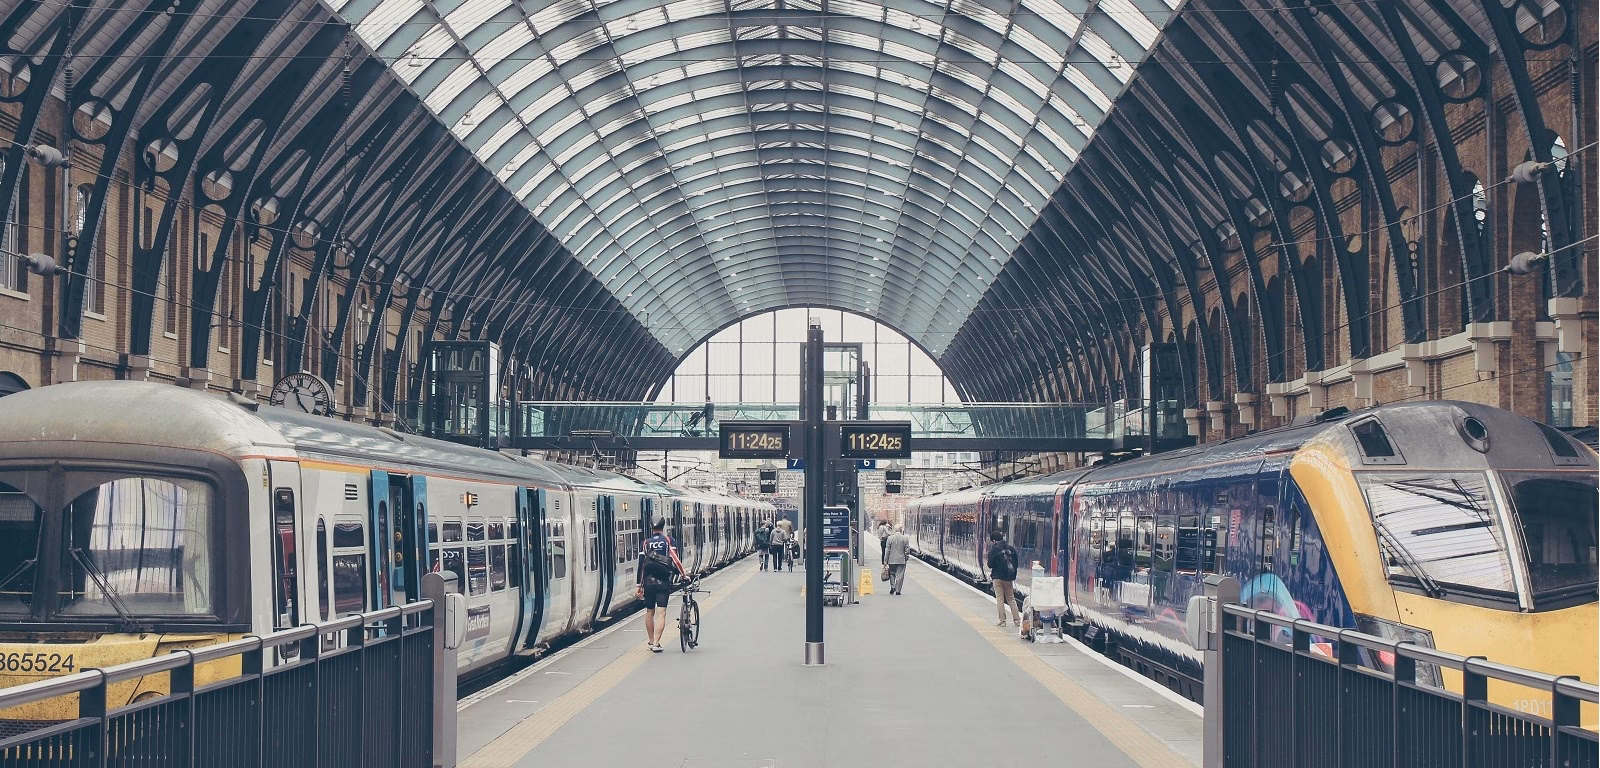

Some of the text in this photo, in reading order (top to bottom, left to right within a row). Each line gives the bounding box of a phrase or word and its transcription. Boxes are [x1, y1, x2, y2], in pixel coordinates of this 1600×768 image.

[791, 458, 799, 467] 7
[863, 458, 871, 467] 6
[649, 541, 664, 549] TCC
